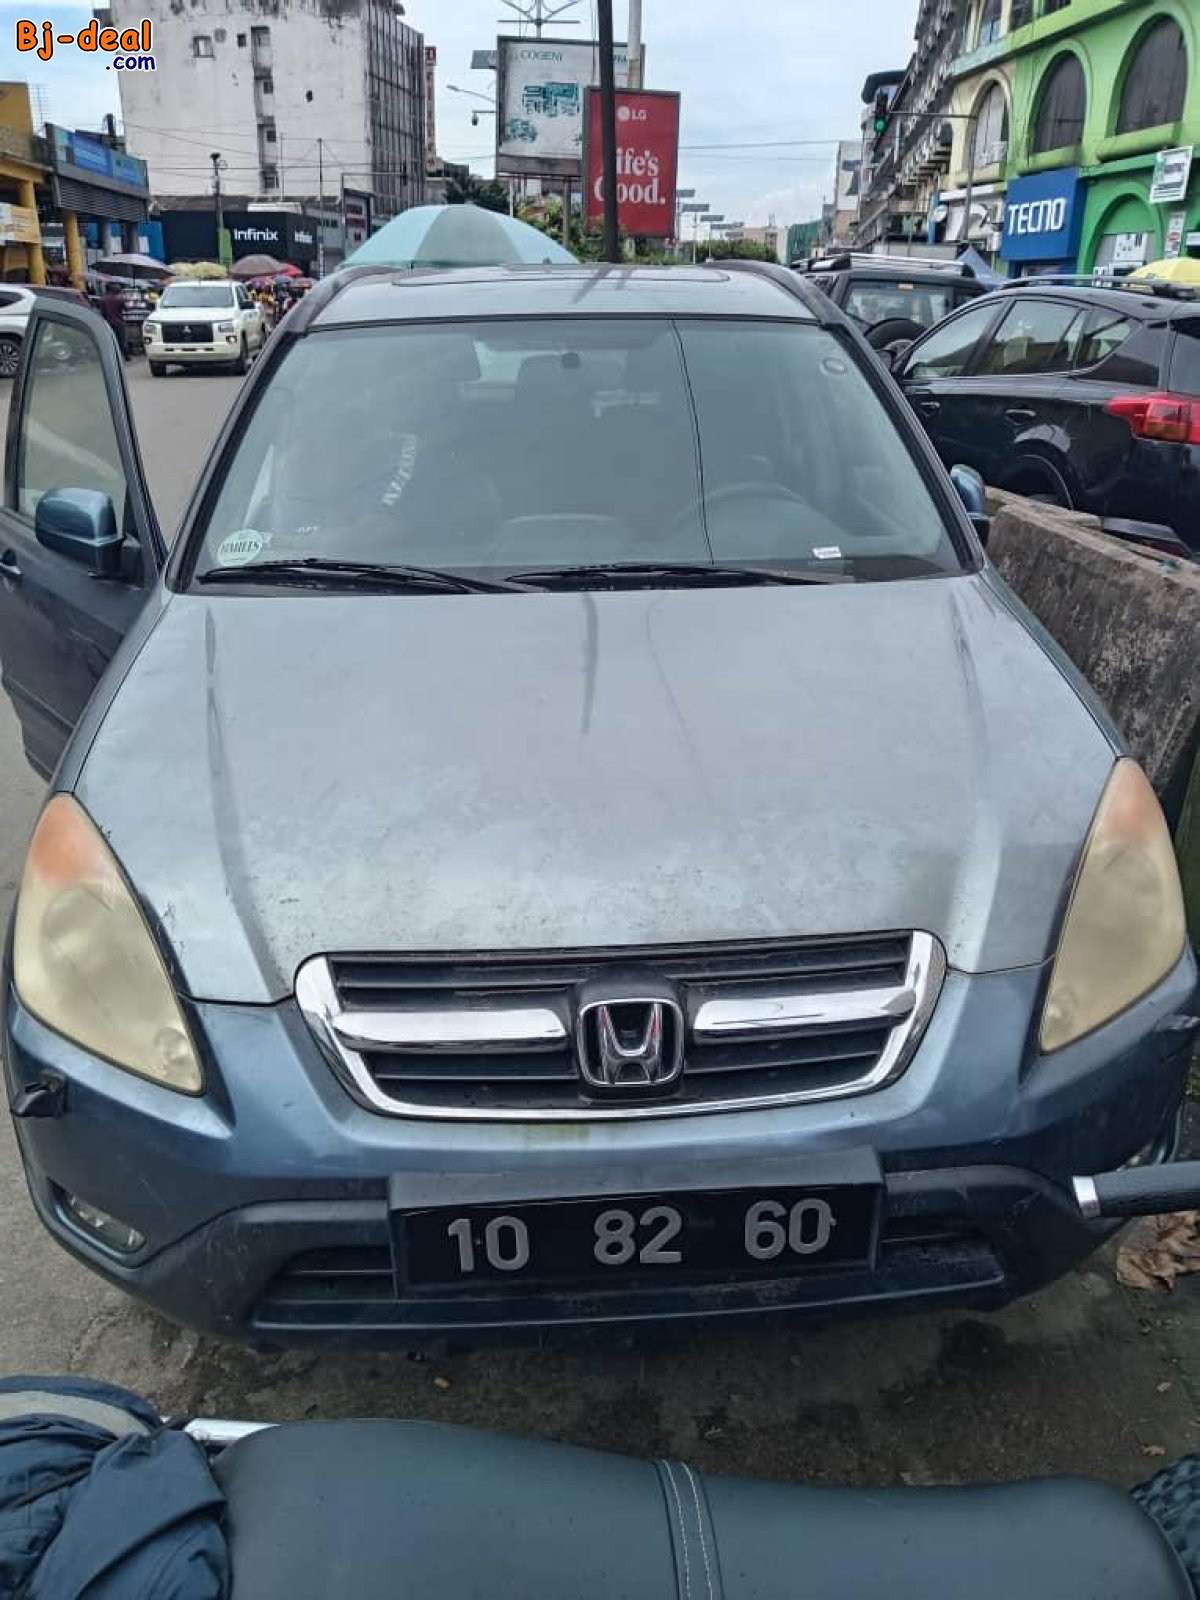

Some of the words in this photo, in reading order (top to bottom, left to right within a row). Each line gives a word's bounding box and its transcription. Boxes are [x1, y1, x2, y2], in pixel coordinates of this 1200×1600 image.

[632, 109, 647, 120] LG
[602, 147, 659, 177] ife's
[1008, 197, 1067, 235] TECNO
[234, 228, 279, 241] Infinix
[447, 1215, 530, 1273] 10
[593, 1205, 682, 1266] 82
[744, 1197, 833, 1260] 60
